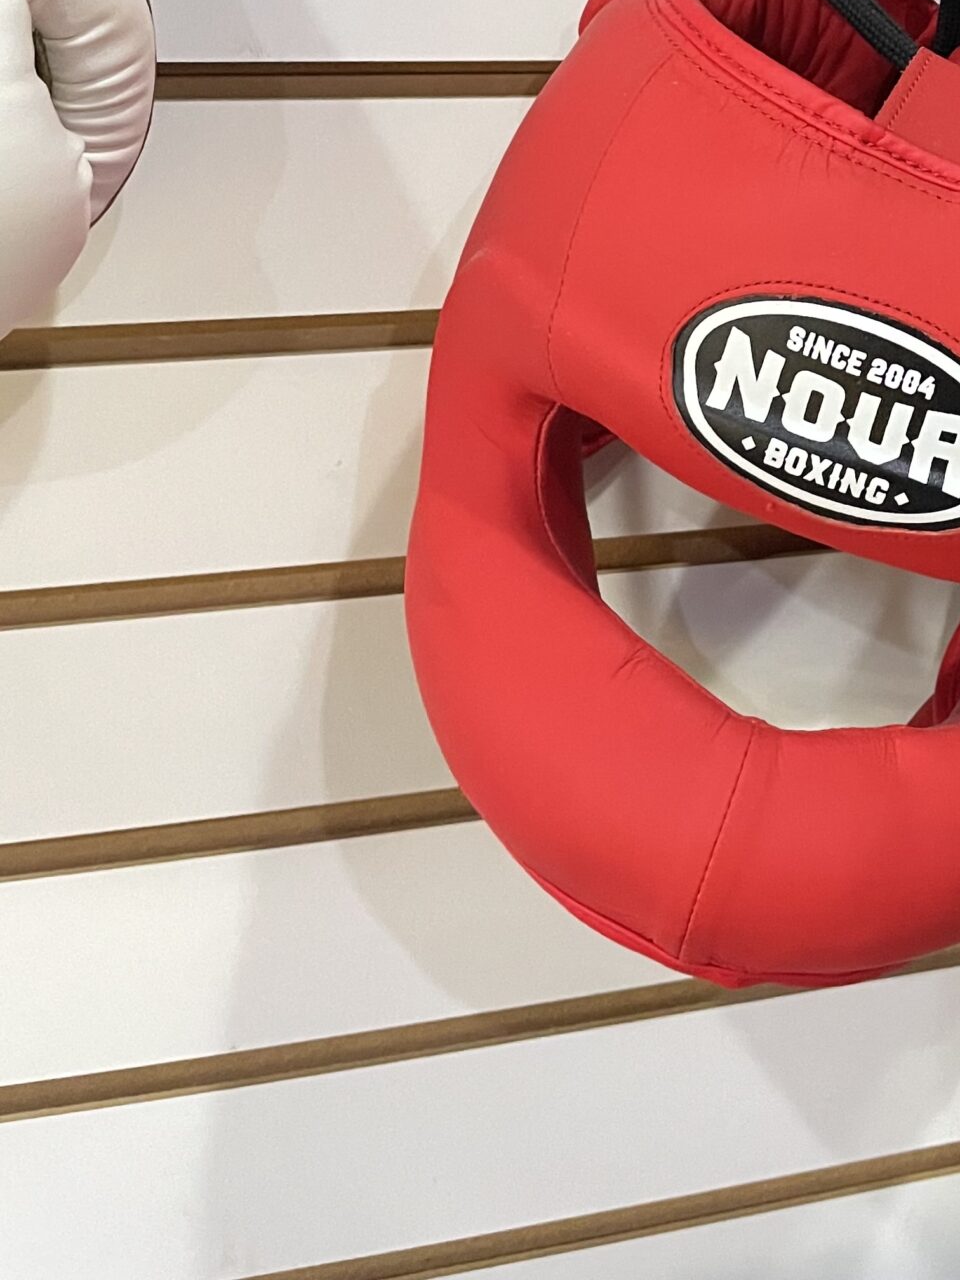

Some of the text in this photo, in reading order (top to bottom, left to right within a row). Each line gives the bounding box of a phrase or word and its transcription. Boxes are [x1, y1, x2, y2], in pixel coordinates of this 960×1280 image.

[786, 325, 937, 401] SINCE 2004
[762, 437, 890, 506] BOXING
